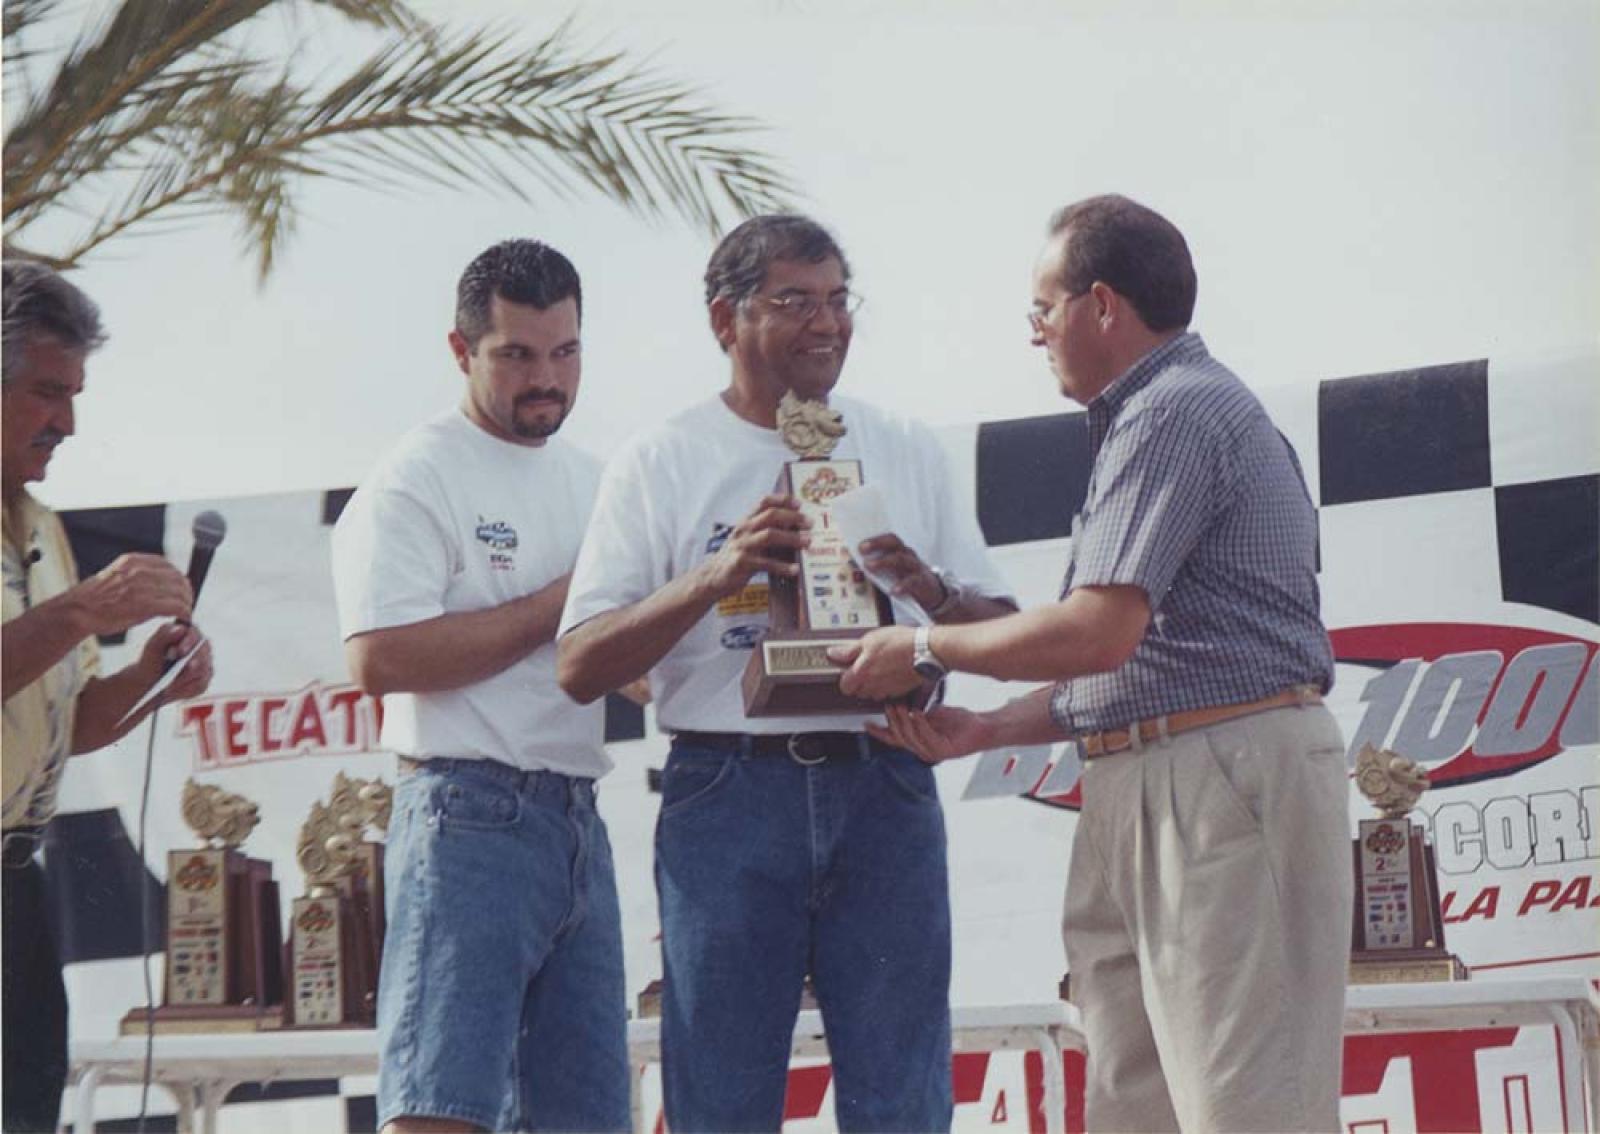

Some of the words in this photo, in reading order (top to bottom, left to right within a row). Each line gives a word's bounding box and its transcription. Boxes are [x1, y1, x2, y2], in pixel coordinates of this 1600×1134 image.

[1412, 785, 1600, 876] COR
[1440, 884, 1501, 924] LA
[1516, 874, 1600, 917] PA
